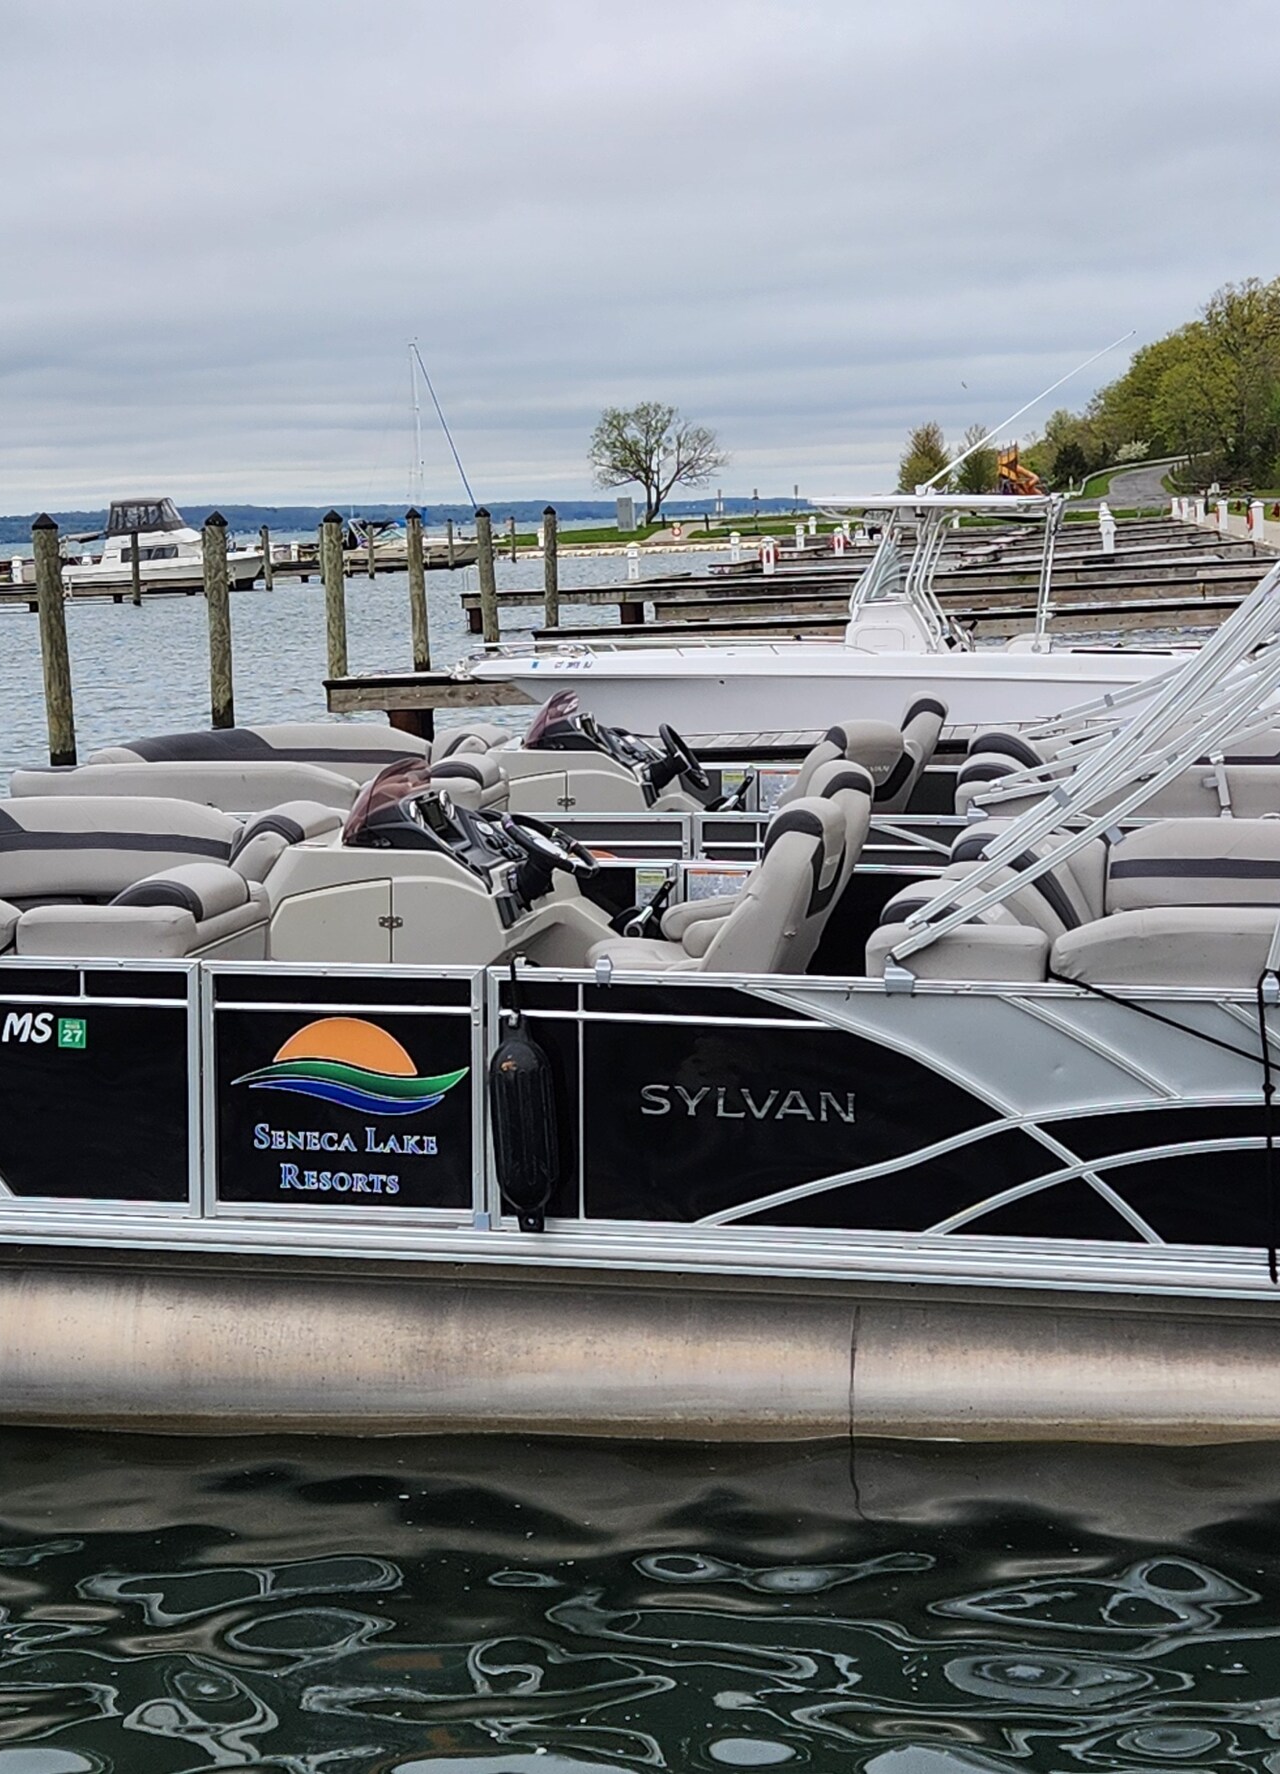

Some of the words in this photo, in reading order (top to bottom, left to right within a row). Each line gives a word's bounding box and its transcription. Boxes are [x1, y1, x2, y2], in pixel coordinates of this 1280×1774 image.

[1, 1012, 54, 1044] MS
[62, 1029, 83, 1042] 27
[640, 1084, 856, 1123] SYLVAN
